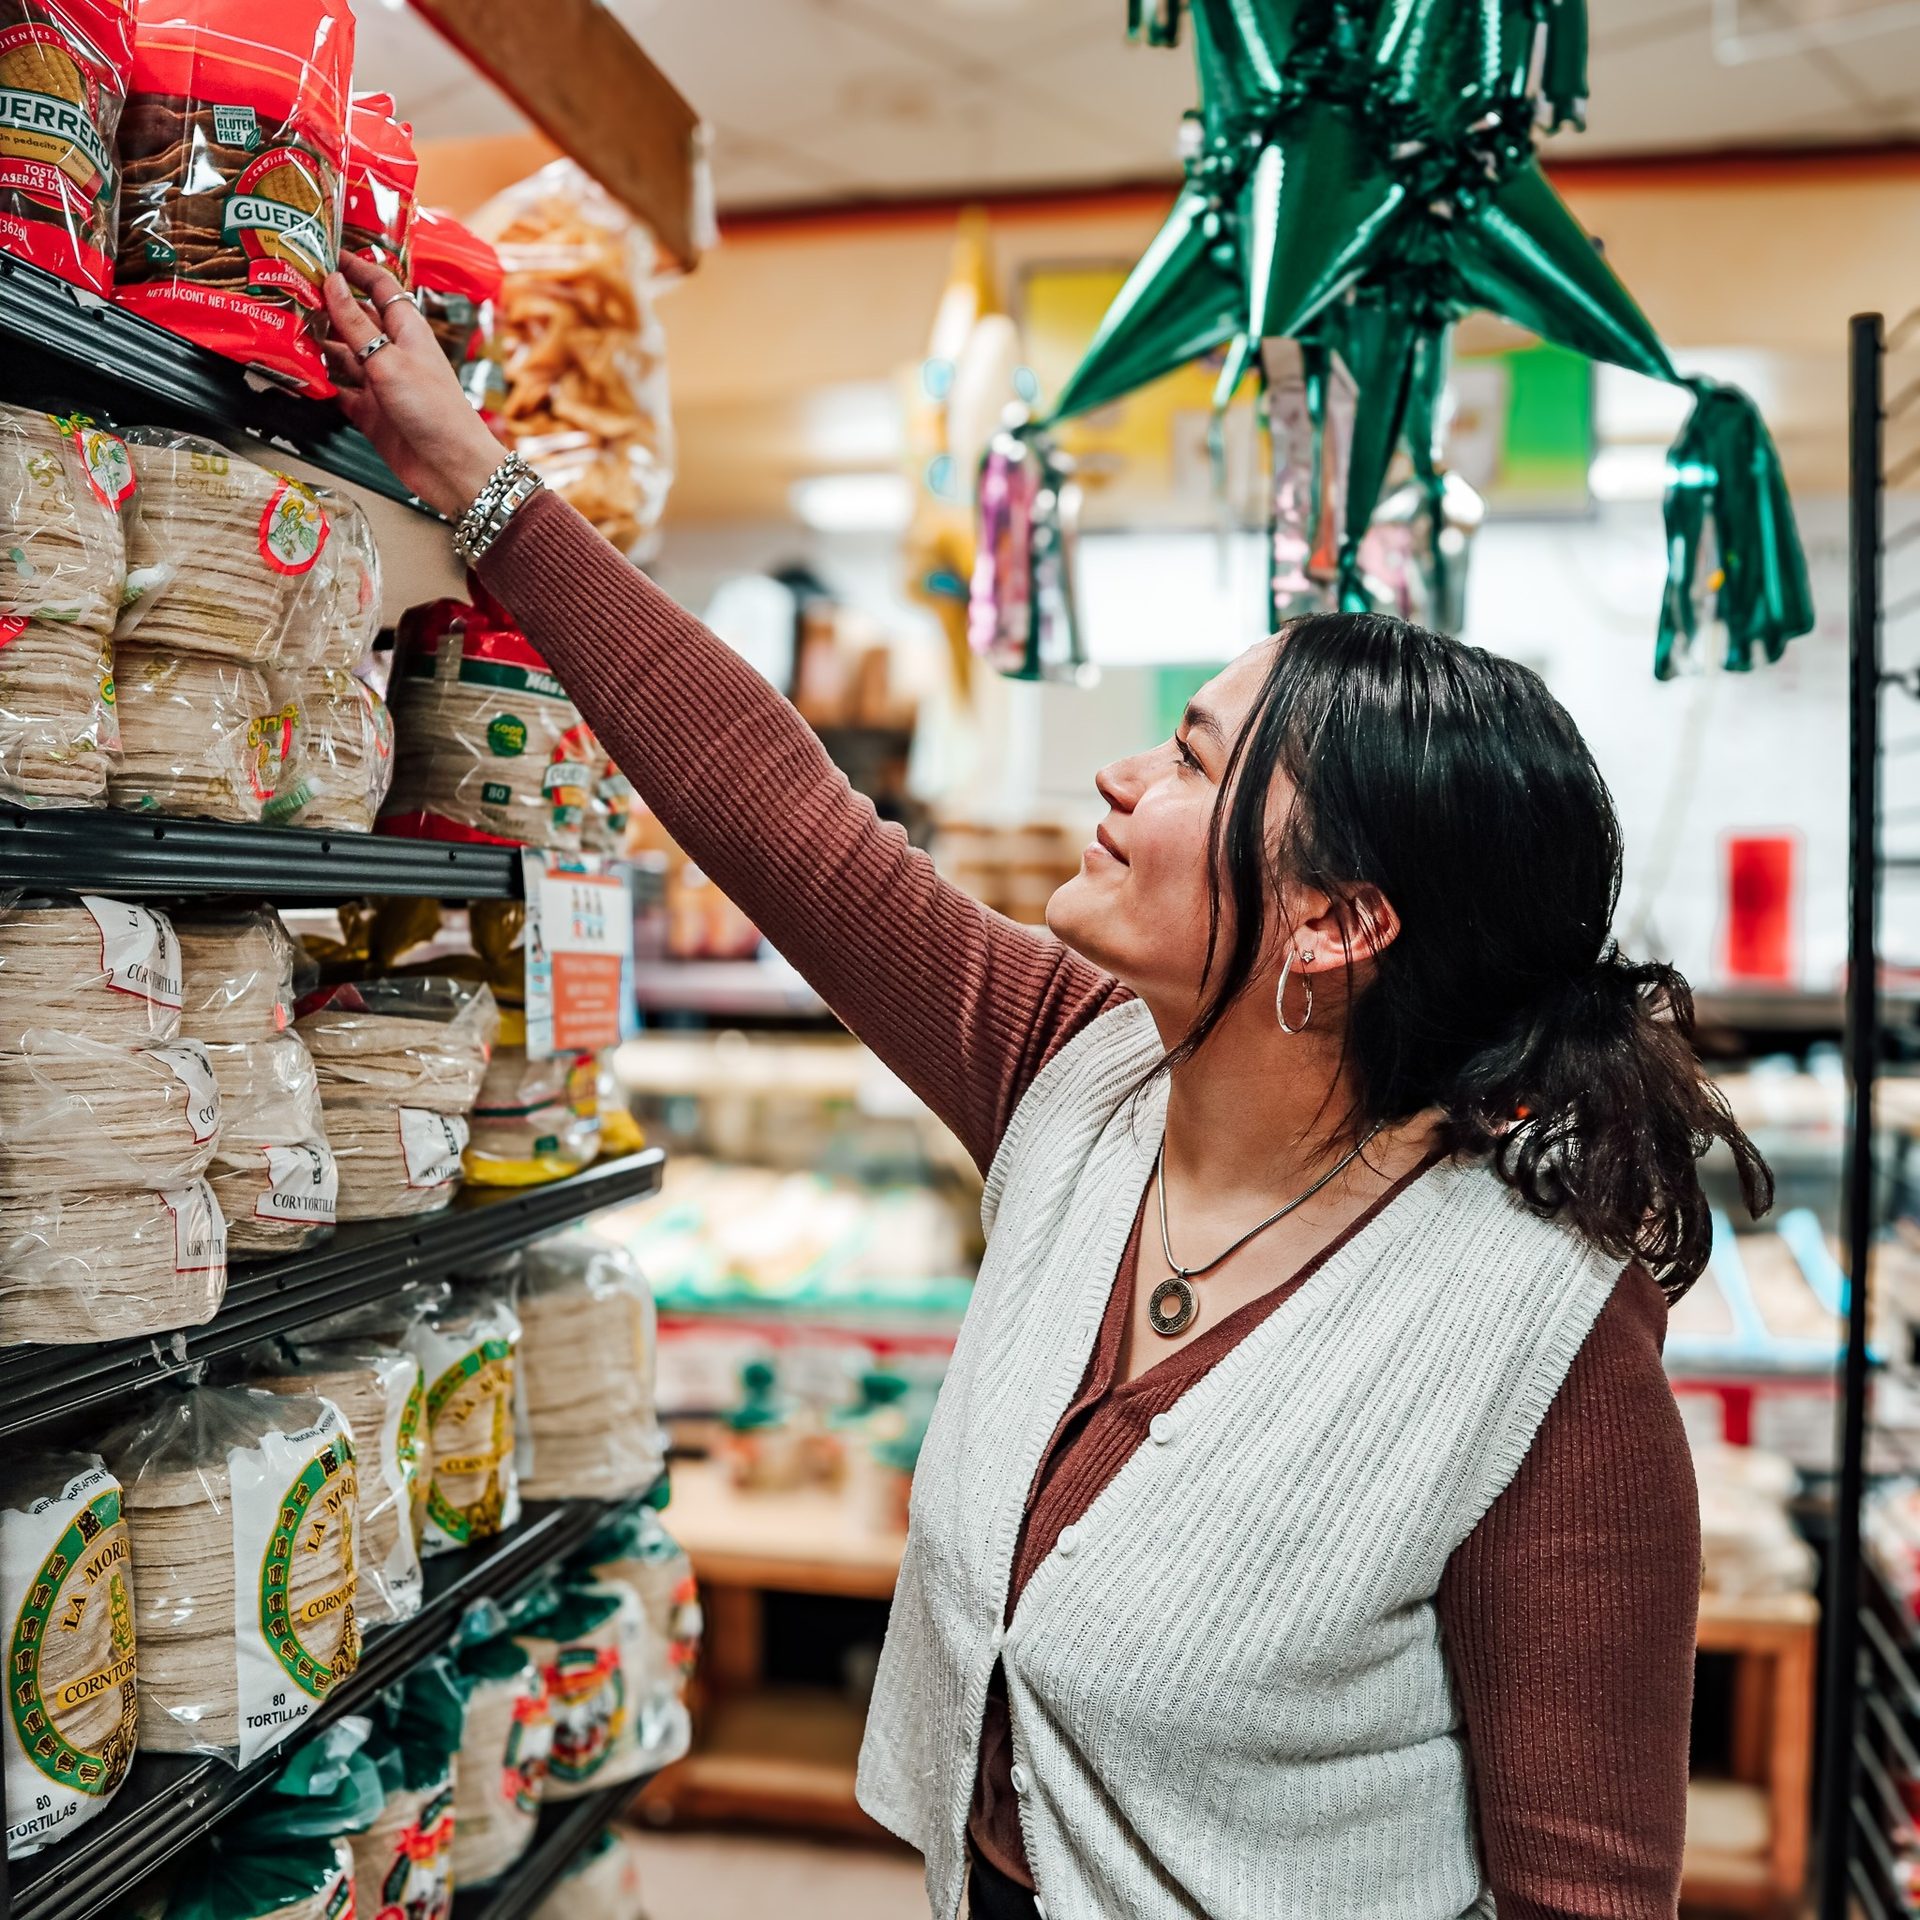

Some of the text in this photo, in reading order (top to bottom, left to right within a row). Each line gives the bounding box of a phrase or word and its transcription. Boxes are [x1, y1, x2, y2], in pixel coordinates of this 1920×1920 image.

[217, 117, 255, 131] GLUTEN
[218, 130, 242, 143] FREE
[13, 136, 57, 151] pedacito
[151, 245, 170, 258] 22
[208, 295, 228, 310] NET.
[230, 299, 249, 315] 12.8
[248, 304, 260, 318] OZ
[260, 308, 286, 331] (362g)
[190, 450, 230, 476] 50
[488, 786, 506, 799] 80
[307, 1523, 327, 1551] LA
[62, 1597, 87, 1630] LA
[308, 1592, 342, 1618] CORN
[64, 1673, 113, 1703] CORN
[272, 1693, 286, 1707] 80
[246, 1704, 309, 1729] TORTILLAS
[36, 1794, 52, 1811] 80
[6, 1801, 77, 1840] TORTILLAS
